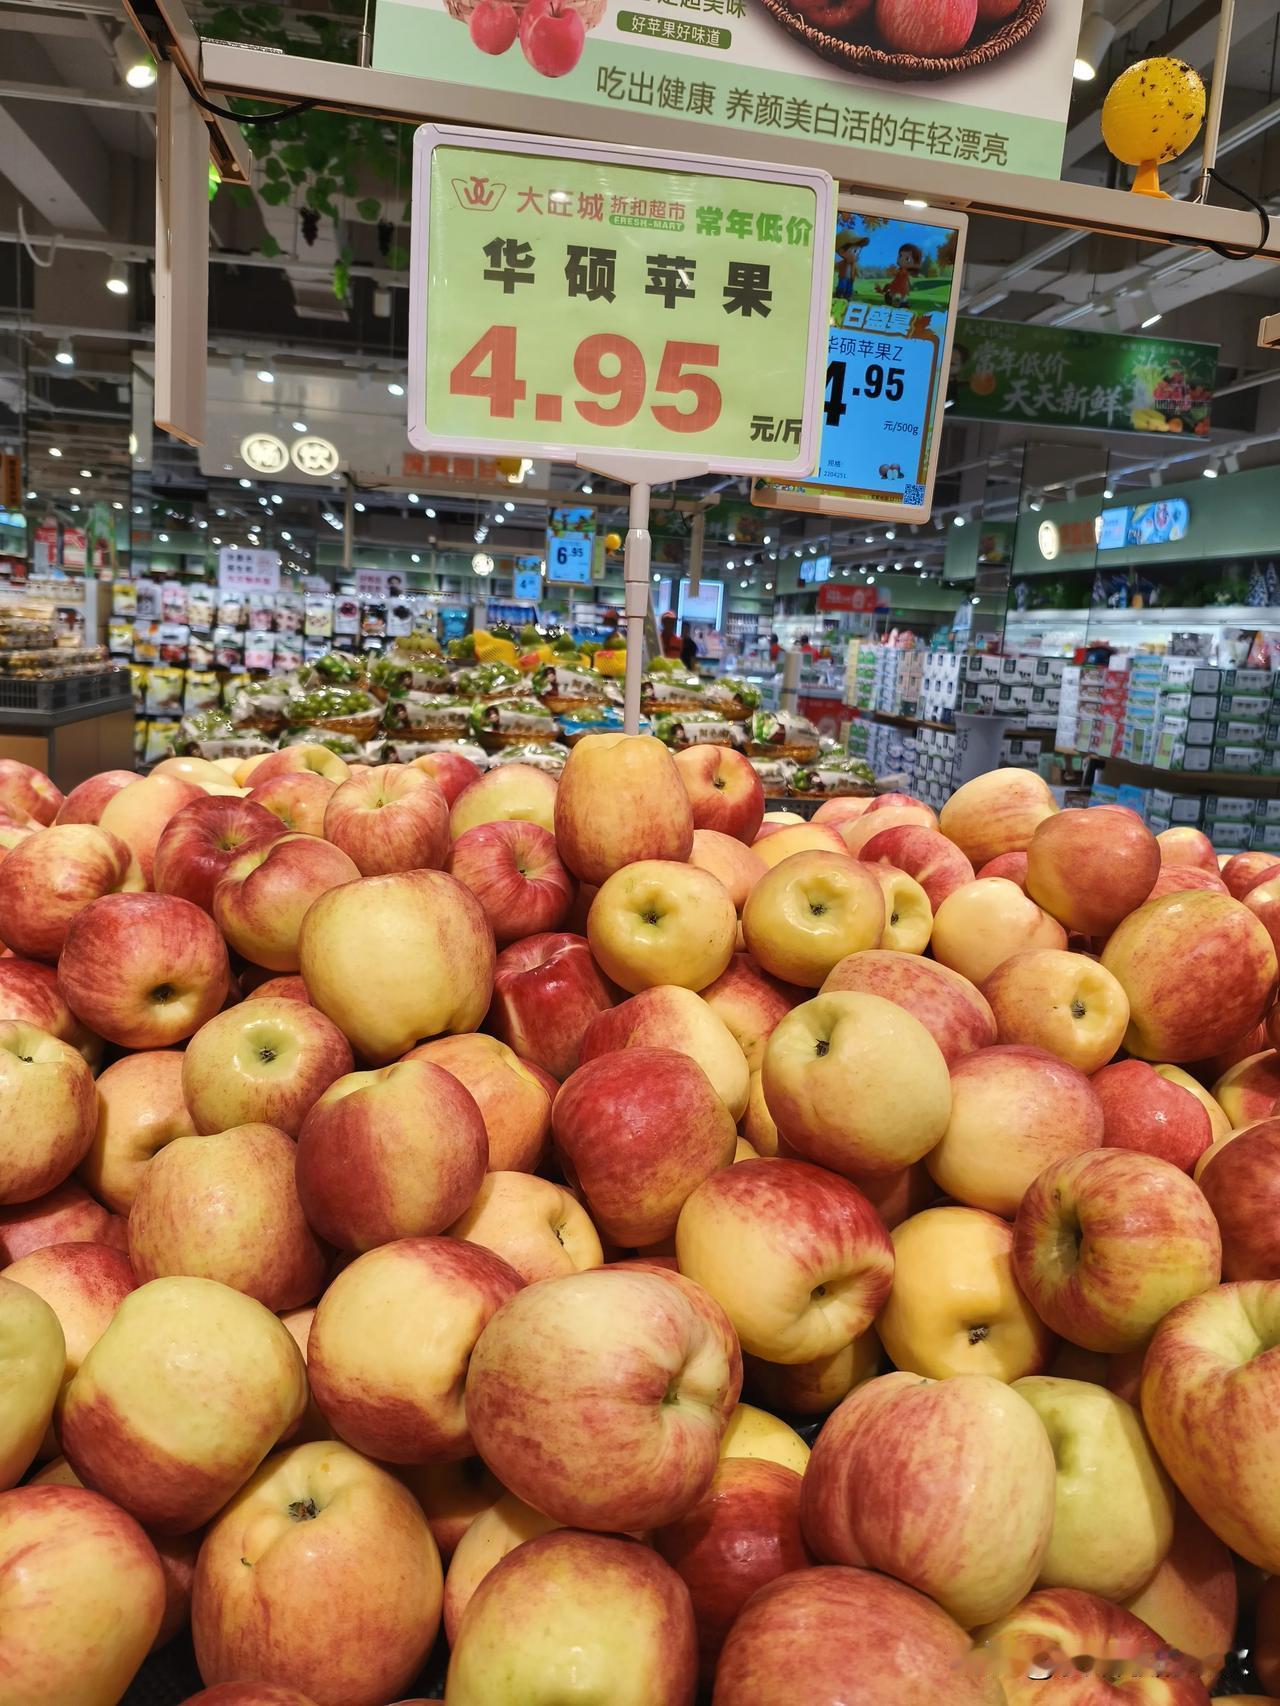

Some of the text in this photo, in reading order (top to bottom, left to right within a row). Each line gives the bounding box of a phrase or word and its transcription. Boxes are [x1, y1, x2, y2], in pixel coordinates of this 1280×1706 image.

[631, 15, 721, 47] 好苹果好味道
[596, 65, 1010, 166] 吃出健康 养颜美白活的年轻漂亮
[610, 195, 686, 221] 折扣超市
[613, 217, 684, 231] FRESH-MART
[695, 205, 814, 247] 常年低价
[483, 237, 773, 319] 华硕苹果
[450, 324, 723, 433] 4.95
[972, 341, 1072, 386] 常年低价
[998, 378, 1123, 427] 天天新鲜
[883, 420, 919, 436] 元/500g
